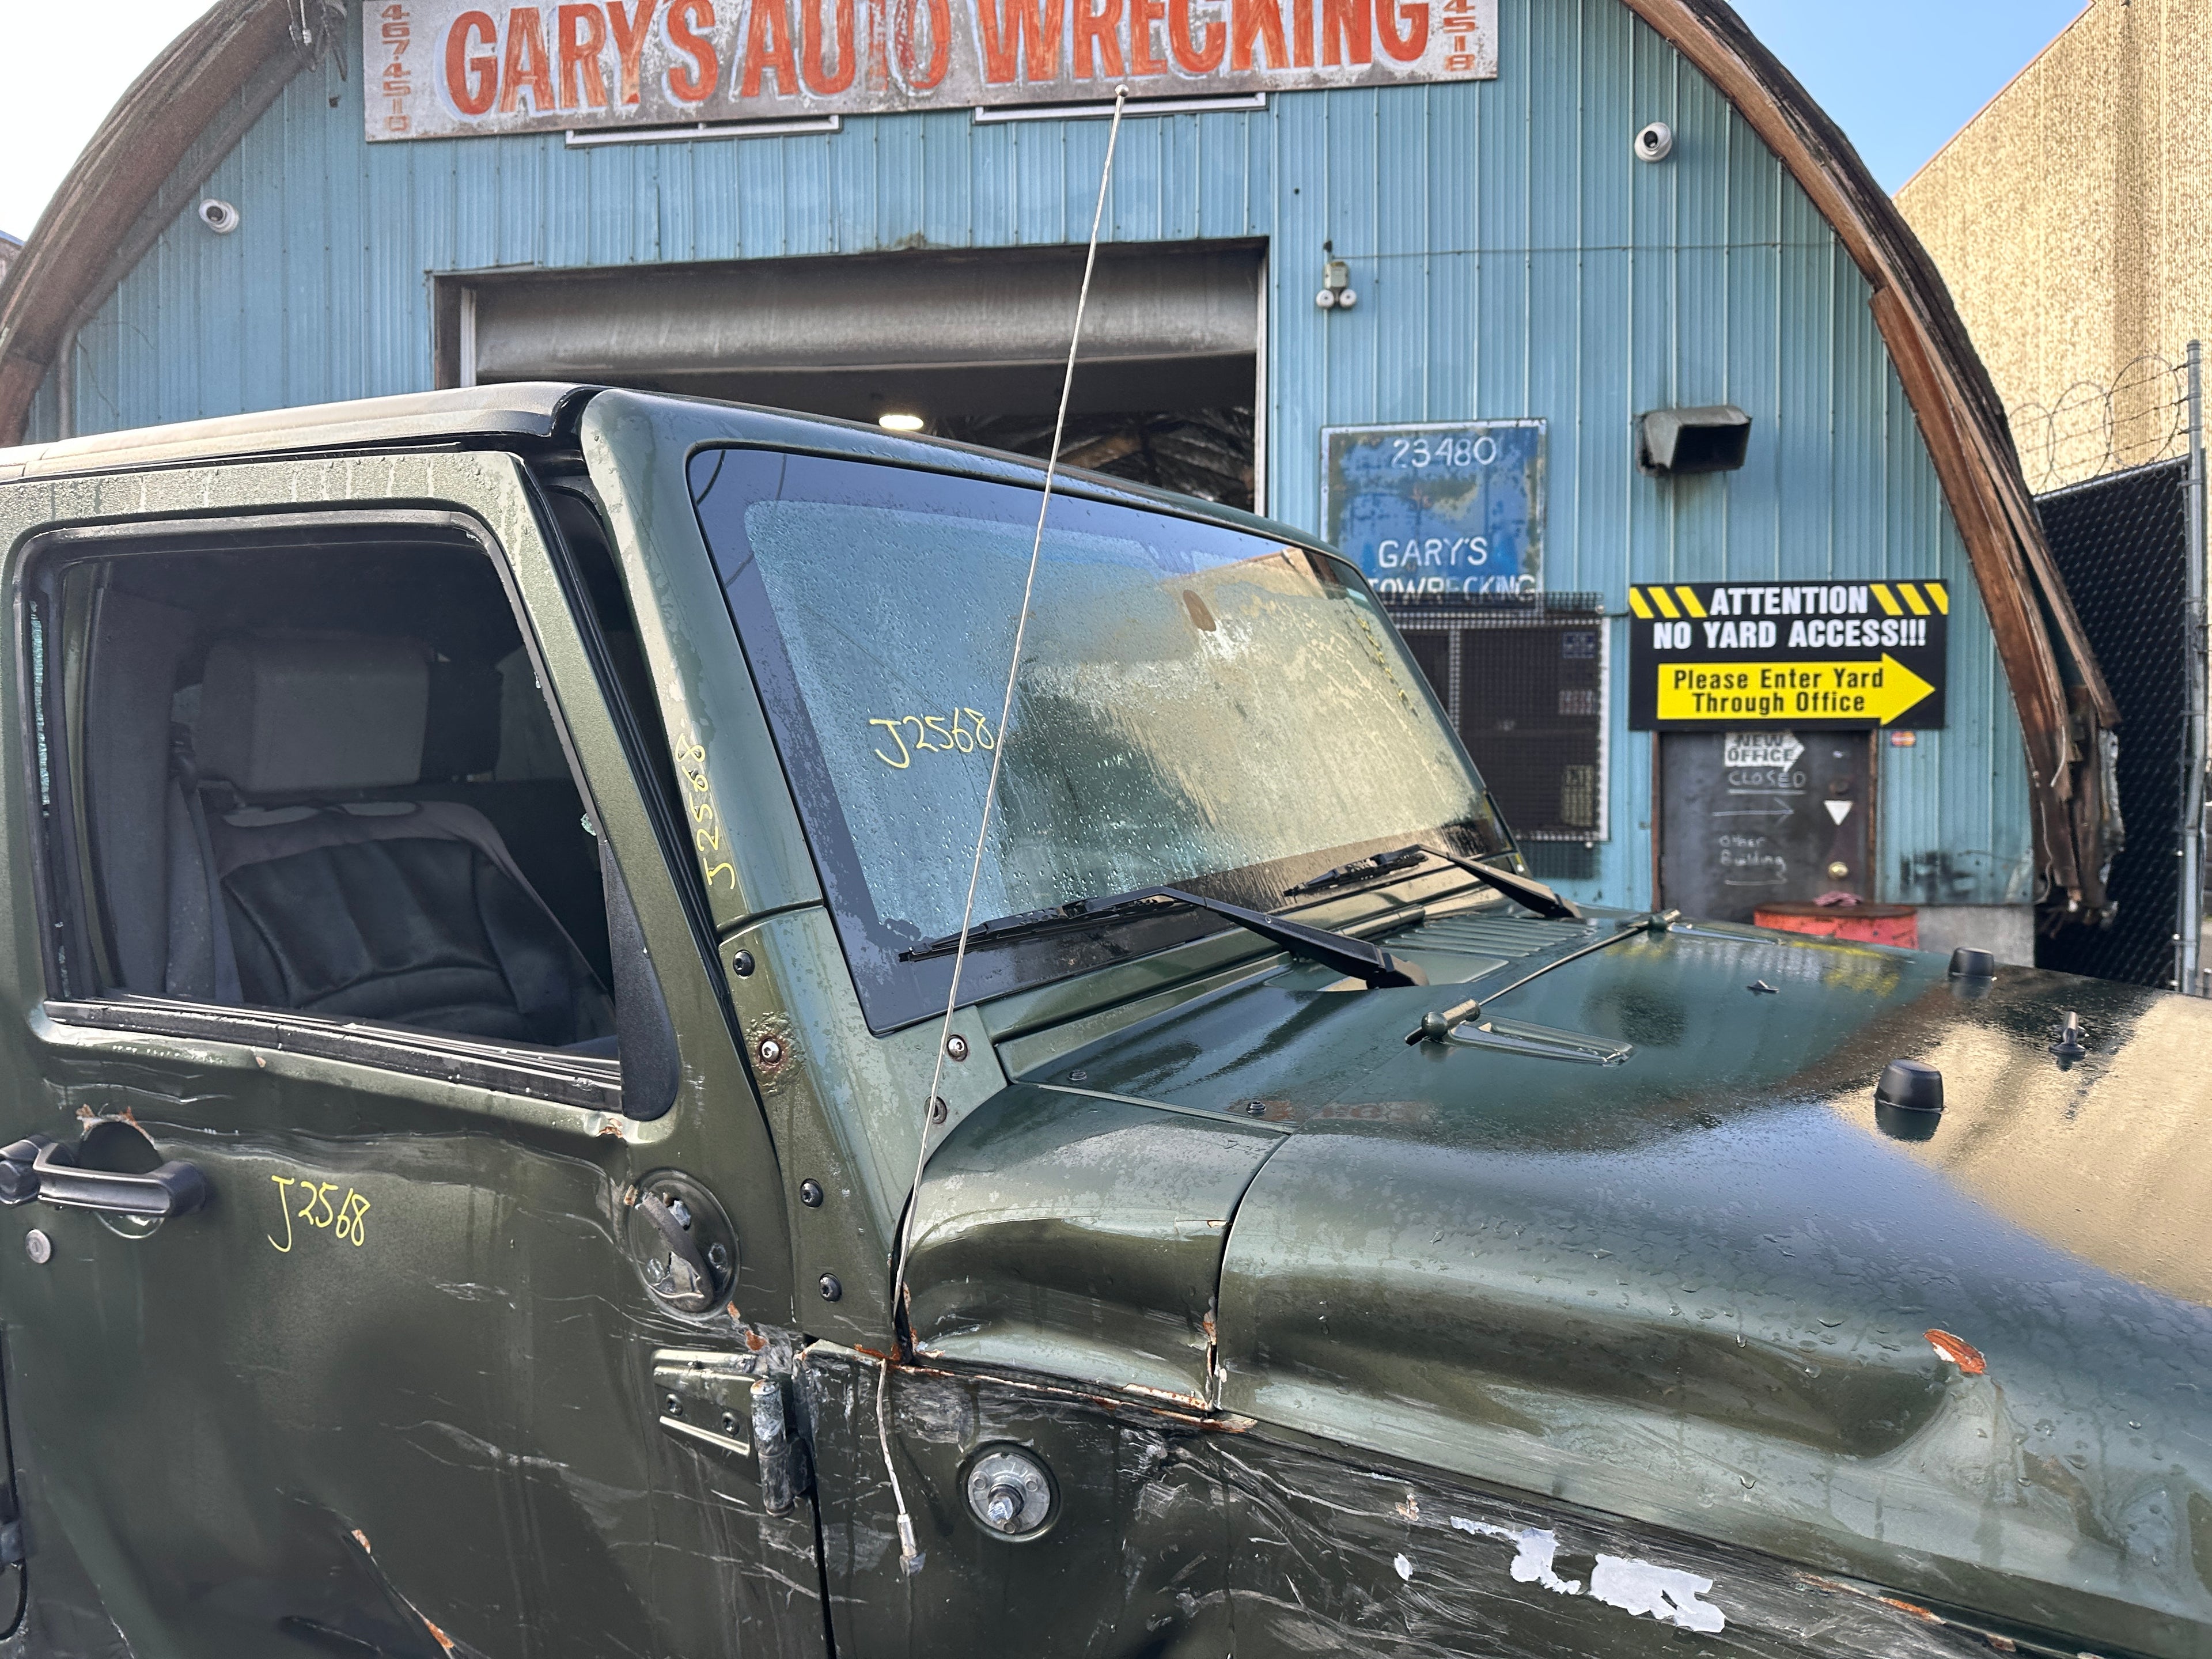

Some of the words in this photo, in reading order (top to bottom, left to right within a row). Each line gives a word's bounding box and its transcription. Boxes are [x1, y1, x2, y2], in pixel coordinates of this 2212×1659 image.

[979, 0, 1430, 84] WRECKING
[1391, 435, 1497, 468] 23480
[1378, 536, 1488, 569] GARY'S
[1710, 585, 1868, 616] ATTENTION
[1653, 621, 1692, 650] NO
[1703, 620, 1777, 649] YARD
[1788, 618, 1926, 648] ACCESS!!!
[1673, 669, 1749, 690] Please
[1760, 668, 1822, 688] Enter
[1833, 668, 1884, 688] Yard
[1692, 692, 1784, 717] Through
[1796, 692, 1865, 712] Office
[869, 706, 995, 769] J2568
[1735, 733, 1783, 747] NEW
[1728, 748, 1797, 762] OFFICE
[1728, 770, 1806, 788] CLOSED
[675, 733, 736, 890] J2568
[267, 1175, 371, 1253] J2568
